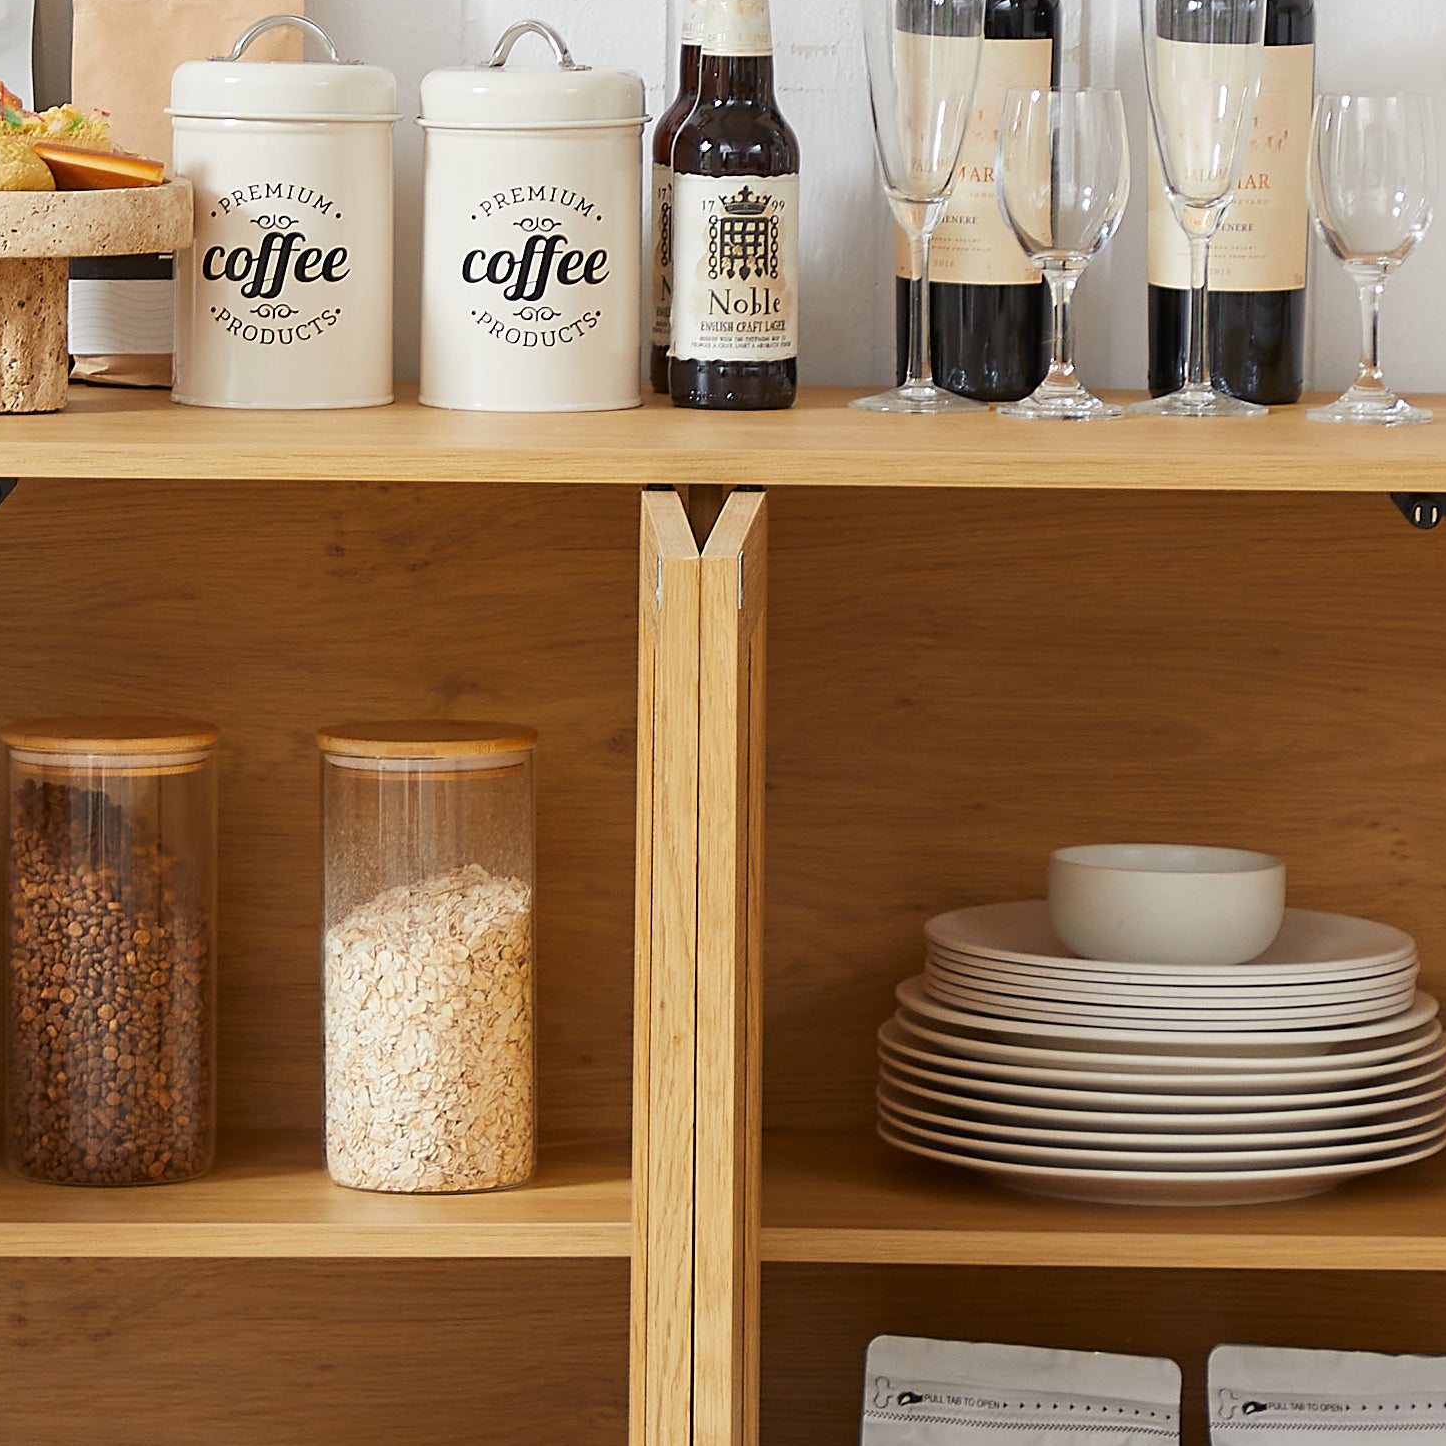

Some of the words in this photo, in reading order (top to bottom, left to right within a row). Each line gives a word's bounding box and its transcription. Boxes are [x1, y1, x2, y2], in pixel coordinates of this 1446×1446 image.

[218, 183, 334, 215] PREMIUM
[479, 185, 595, 217] PREMIUM
[772, 200, 784, 212] 99
[203, 231, 351, 300] coffee
[462, 234, 610, 302] coffee
[709, 287, 781, 316] Noble
[215, 308, 337, 345] PRODUCTS
[476, 310, 598, 347] PRODUCTS
[700, 321, 734, 332] ENGLISH
[736, 320, 763, 333] CRAFT
[765, 320, 786, 332] LAGER
[924, 1393, 944, 1404] PULL
[946, 1395, 962, 1406] TAB
[963, 1397, 975, 1407] TO
[976, 1398, 1000, 1409] OPEN
[1268, 1403, 1288, 1411] PULL
[1290, 1402, 1305, 1411] TAB
[1307, 1403, 1318, 1412] TO
[1319, 1403, 1343, 1412] OPEN
